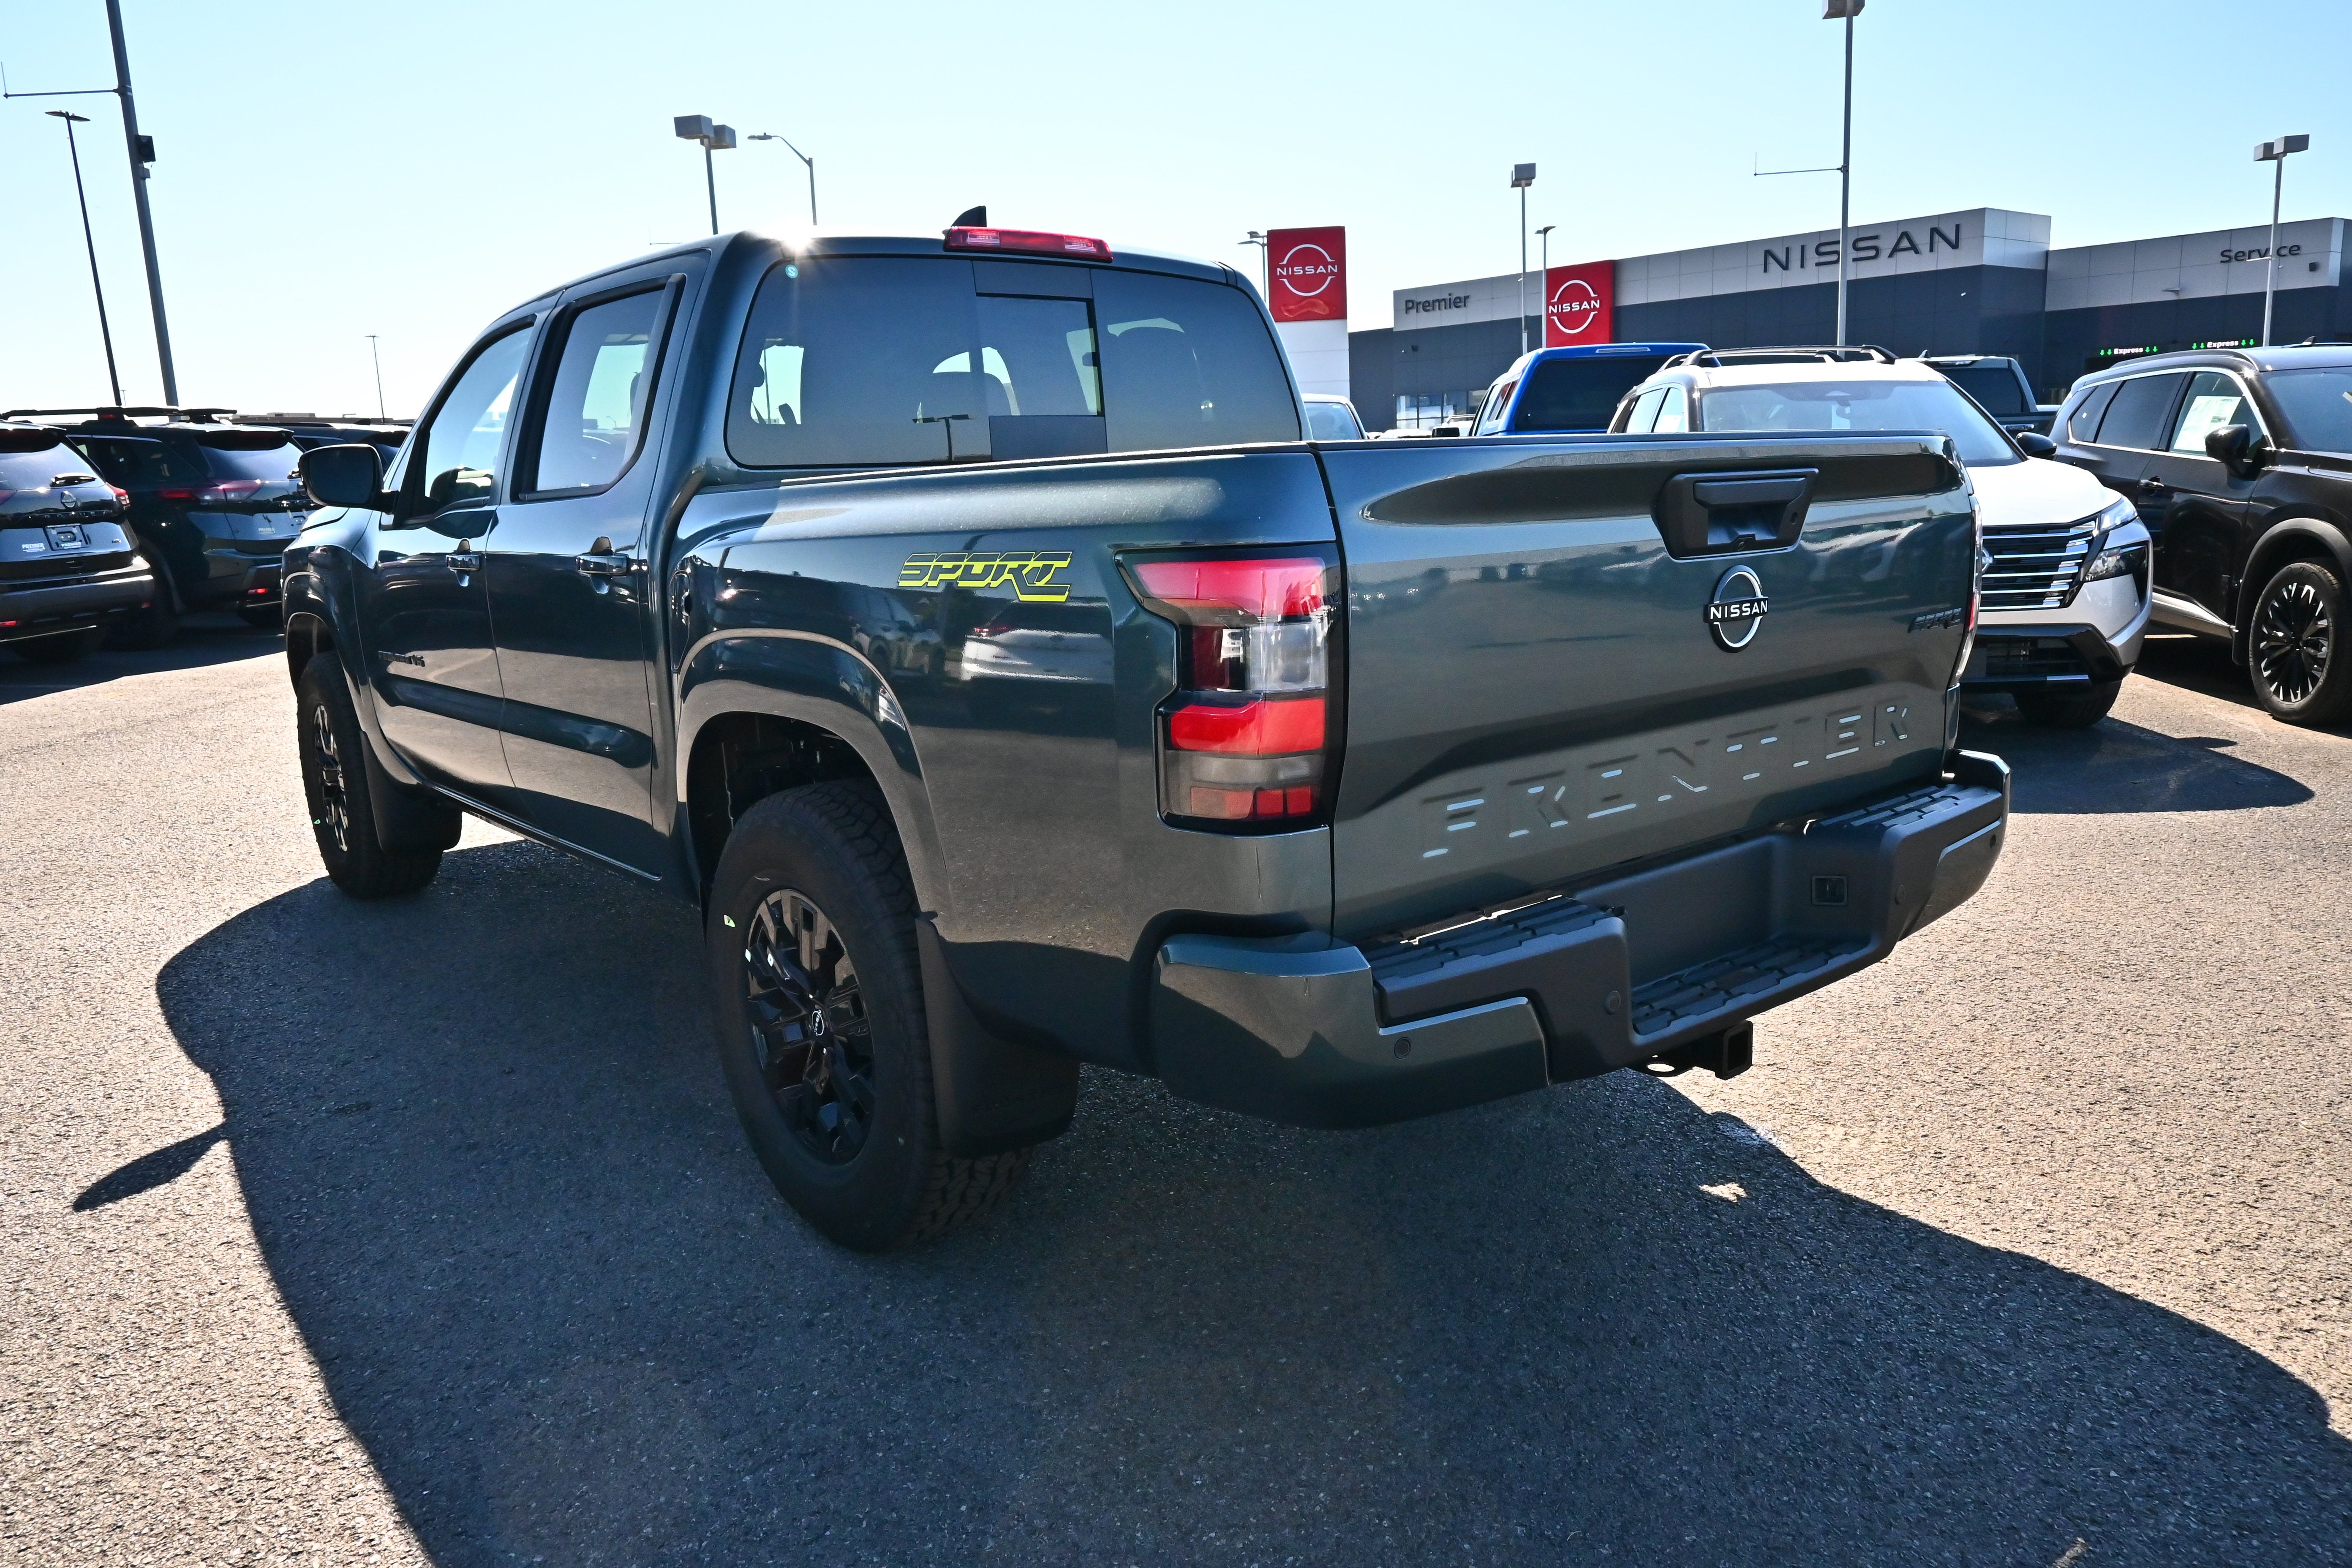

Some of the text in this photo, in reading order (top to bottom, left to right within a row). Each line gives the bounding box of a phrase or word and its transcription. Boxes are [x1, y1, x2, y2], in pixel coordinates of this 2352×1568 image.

[1763, 223, 1961, 273] NISSAN
[2220, 244, 2301, 263] Servce
[1277, 264, 1338, 276] NISSAN
[1405, 293, 1470, 314] Premier
[1549, 299, 1600, 314] NISSAN
[2113, 347, 2143, 355] Express
[2207, 340, 2239, 348] Express
[898, 551, 1073, 602] SPORT
[1710, 600, 1768, 620] NISSAN
[1420, 696, 1910, 859] FRONTIER
